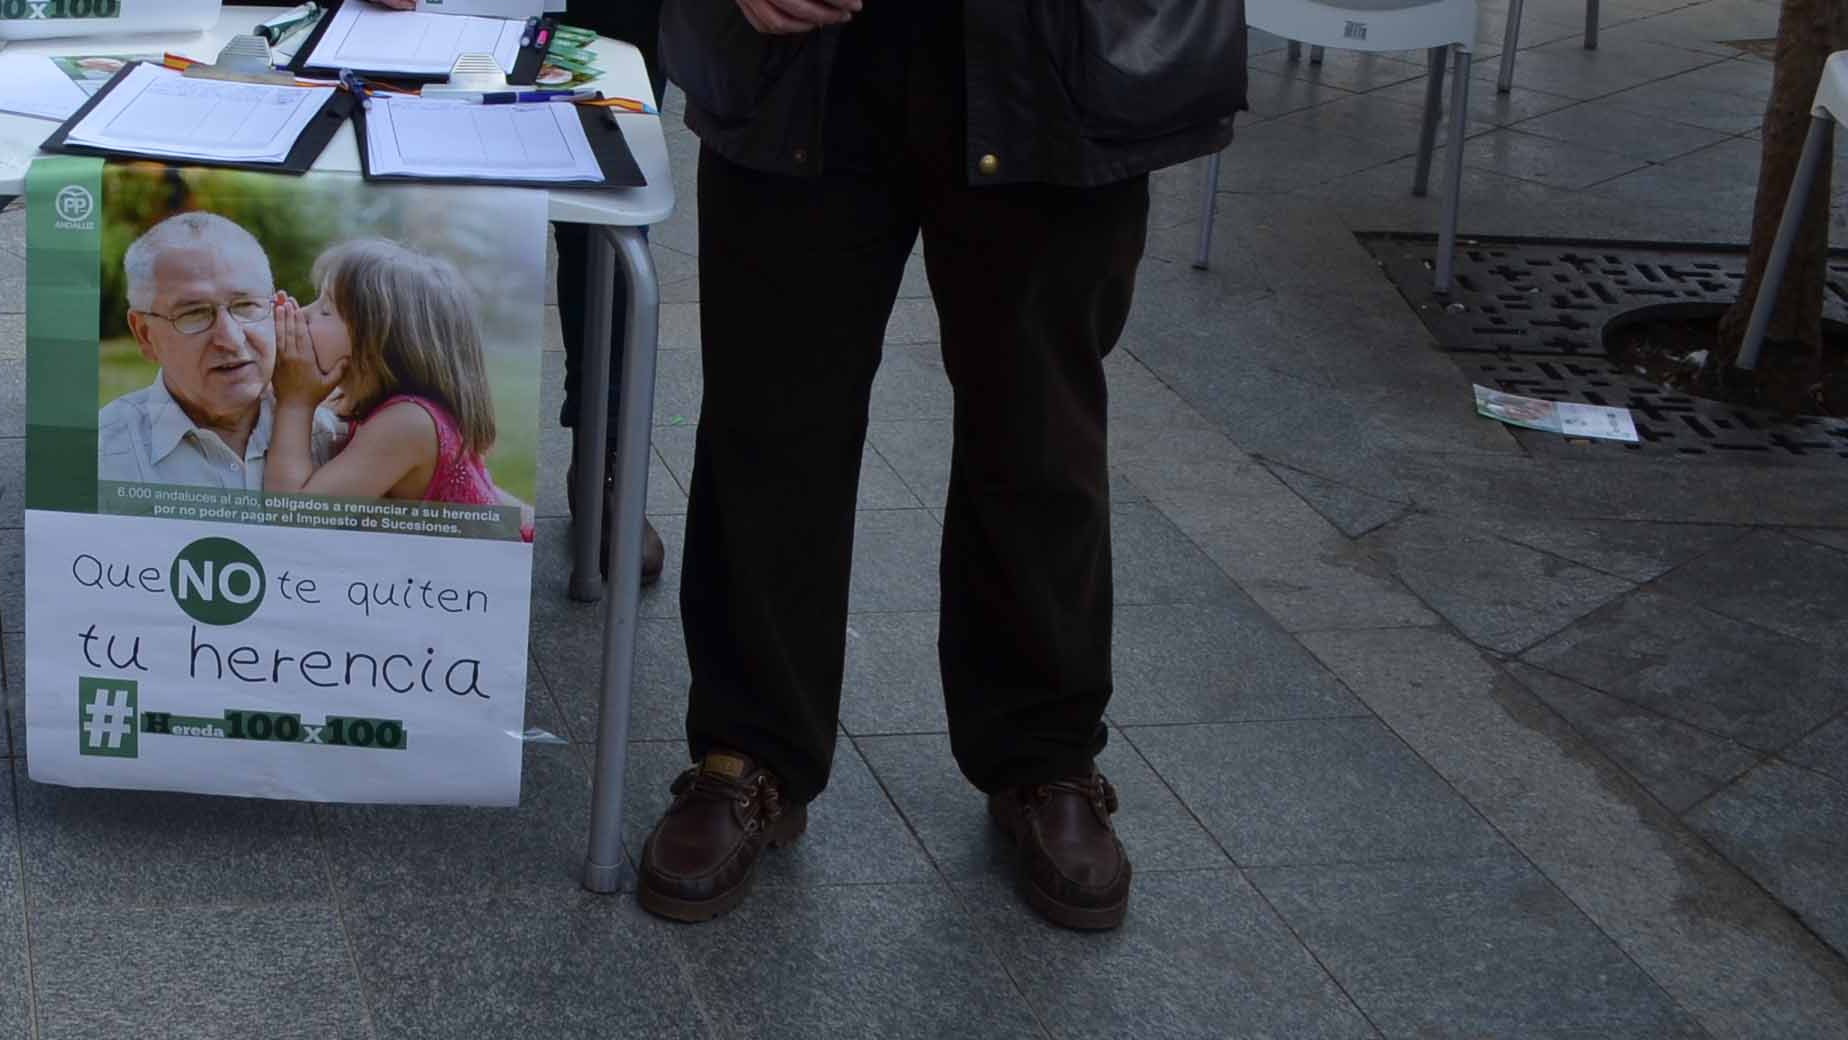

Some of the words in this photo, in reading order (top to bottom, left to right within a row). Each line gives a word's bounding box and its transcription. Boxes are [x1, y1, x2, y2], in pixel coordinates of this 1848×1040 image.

[63, 197, 87, 213] PP
[117, 486, 152, 500] 6.000
[155, 488, 218, 506] andaluces
[221, 493, 234, 506] al
[264, 497, 329, 514] obligados
[333, 504, 343, 512] a
[345, 502, 408, 516] renunciar
[411, 507, 419, 517] a
[423, 509, 440, 518] su
[442, 508, 500, 522] herencia
[153, 506, 175, 518] por
[179, 507, 196, 517] no
[199, 506, 237, 522] poder
[240, 511, 278, 526] pagar
[282, 512, 293, 524] el
[296, 512, 357, 530] Impuesto
[361, 516, 378, 529] de
[381, 516, 462, 534] Sucesiones.
[72, 553, 166, 593] Que
[177, 558, 261, 605] NO
[277, 570, 321, 605] te
[348, 577, 489, 616] quiten
[78, 624, 149, 671] tu
[189, 625, 491, 699] herencia
